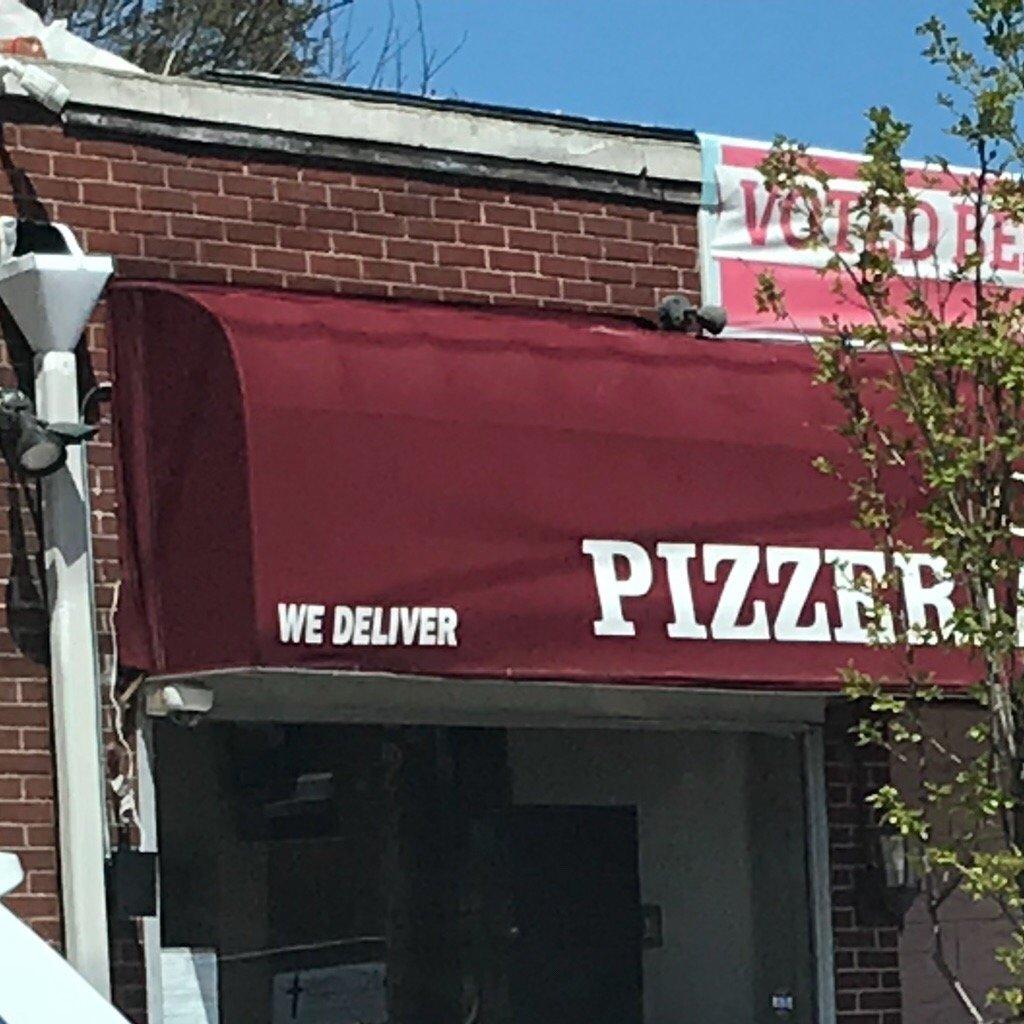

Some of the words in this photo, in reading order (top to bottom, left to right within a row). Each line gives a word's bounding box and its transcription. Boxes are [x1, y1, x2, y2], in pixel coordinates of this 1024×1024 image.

[740, 180, 940, 260] VOTD
[277, 603, 325, 645] WE
[332, 605, 458, 647] DELIVER
